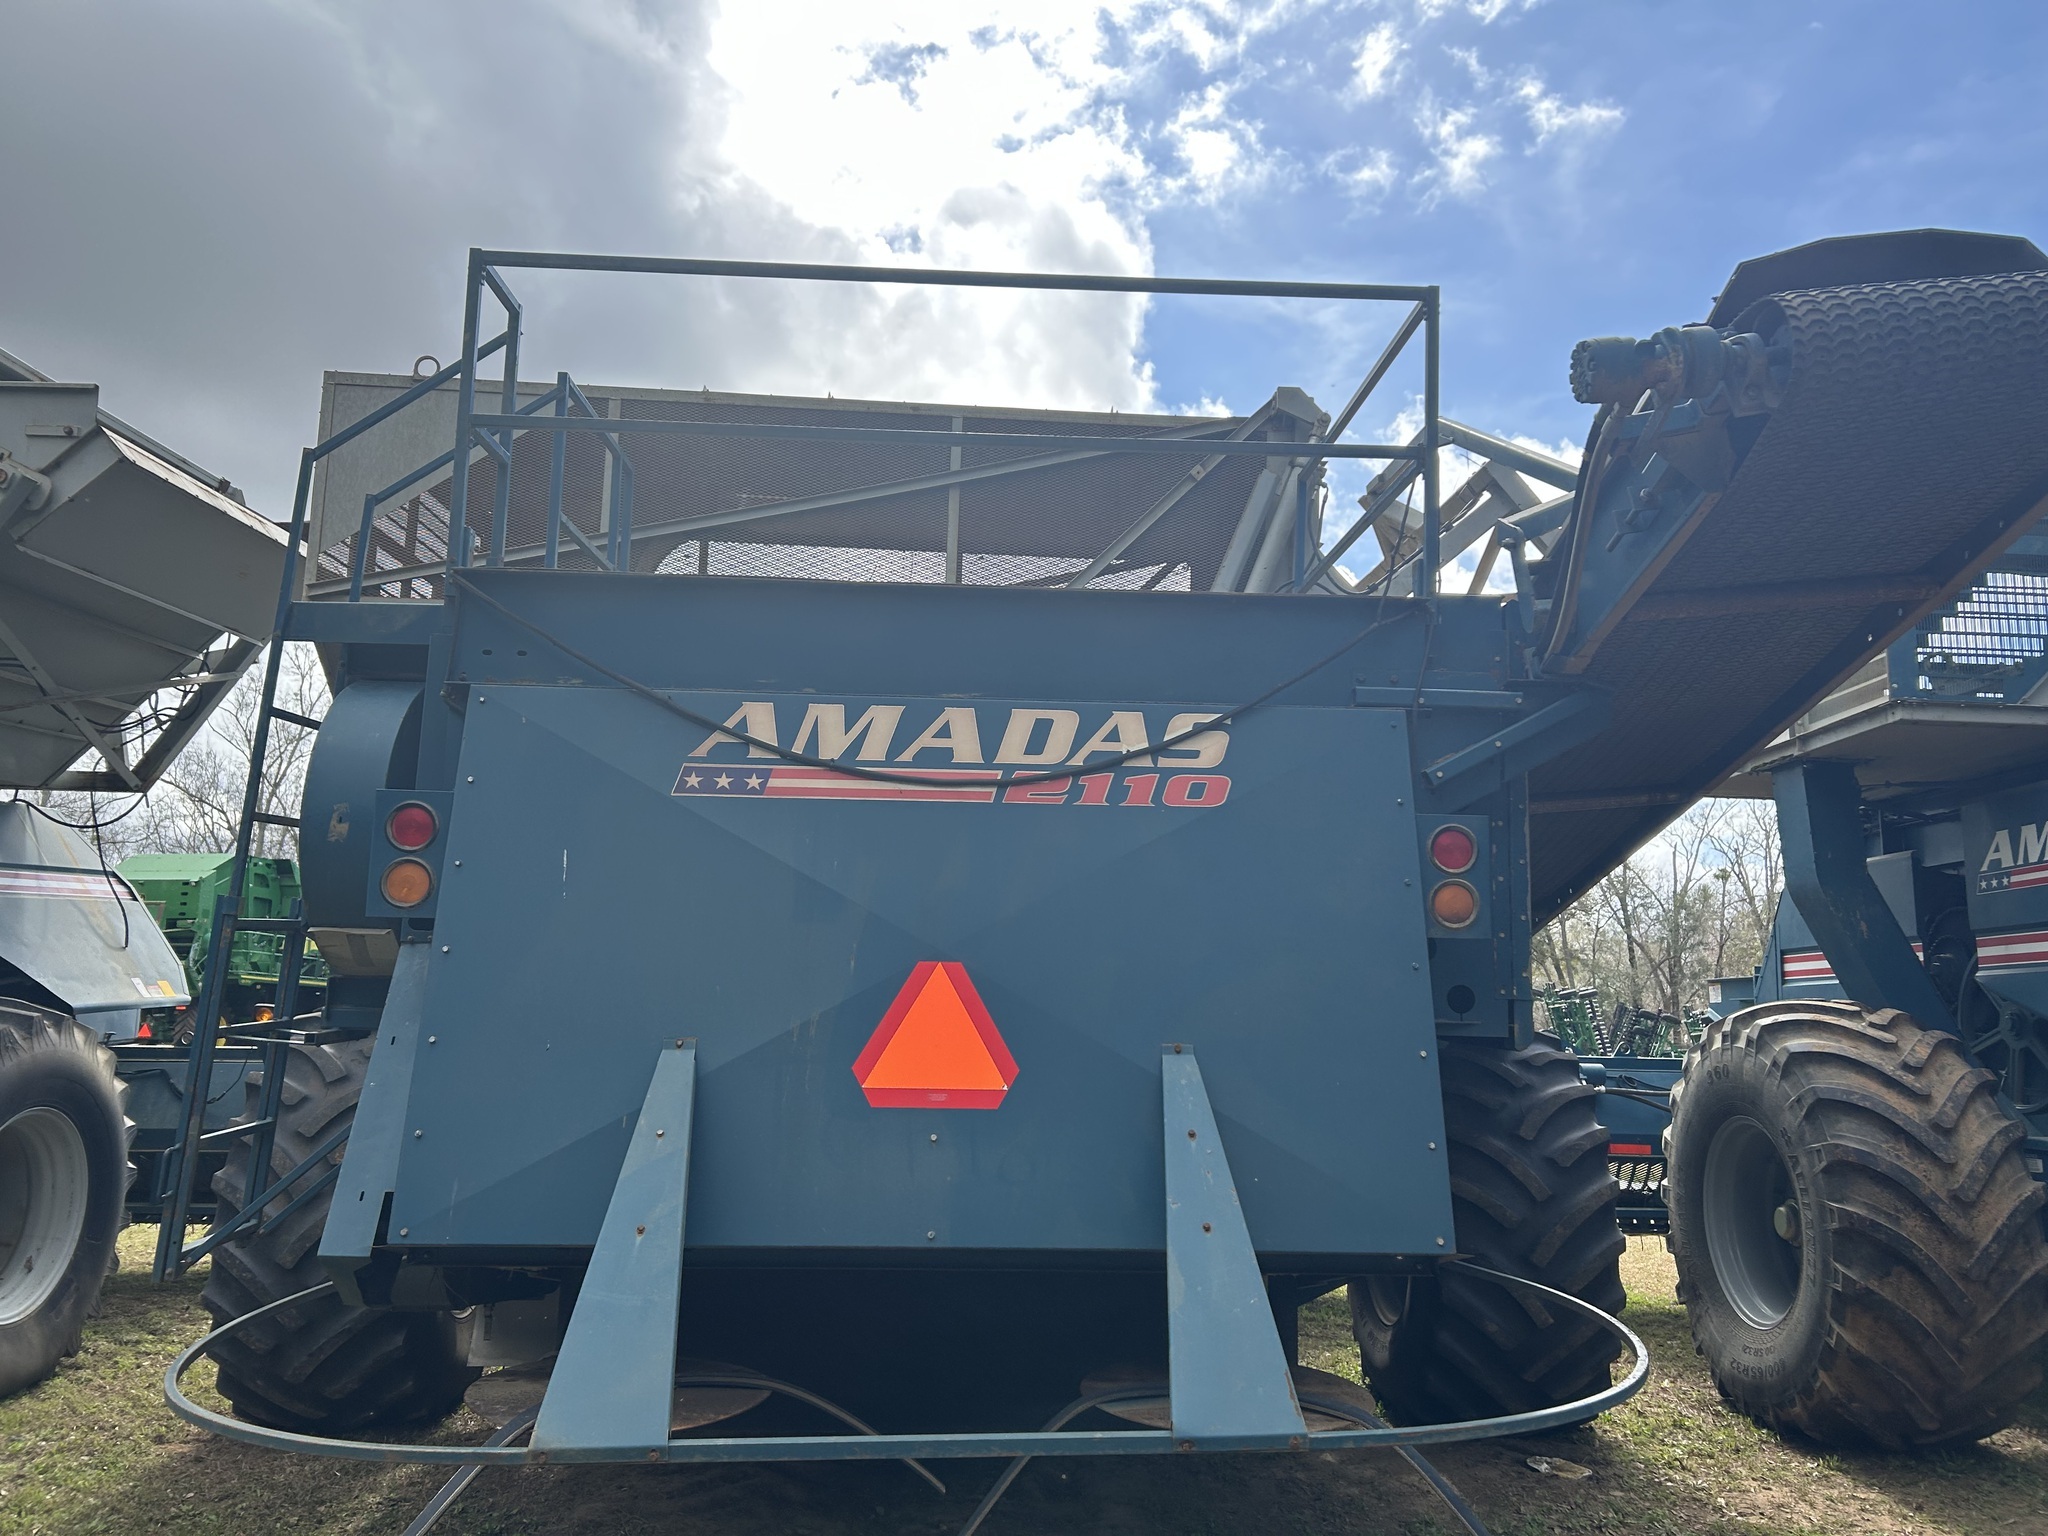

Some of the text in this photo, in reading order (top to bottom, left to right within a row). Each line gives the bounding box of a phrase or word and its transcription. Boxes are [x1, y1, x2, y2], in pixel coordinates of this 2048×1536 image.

[688, 702, 1231, 768] AMADAS
[1002, 771, 1231, 807] 2110
[1980, 820, 2048, 871] AM
[1706, 1063, 1729, 1086] 360
